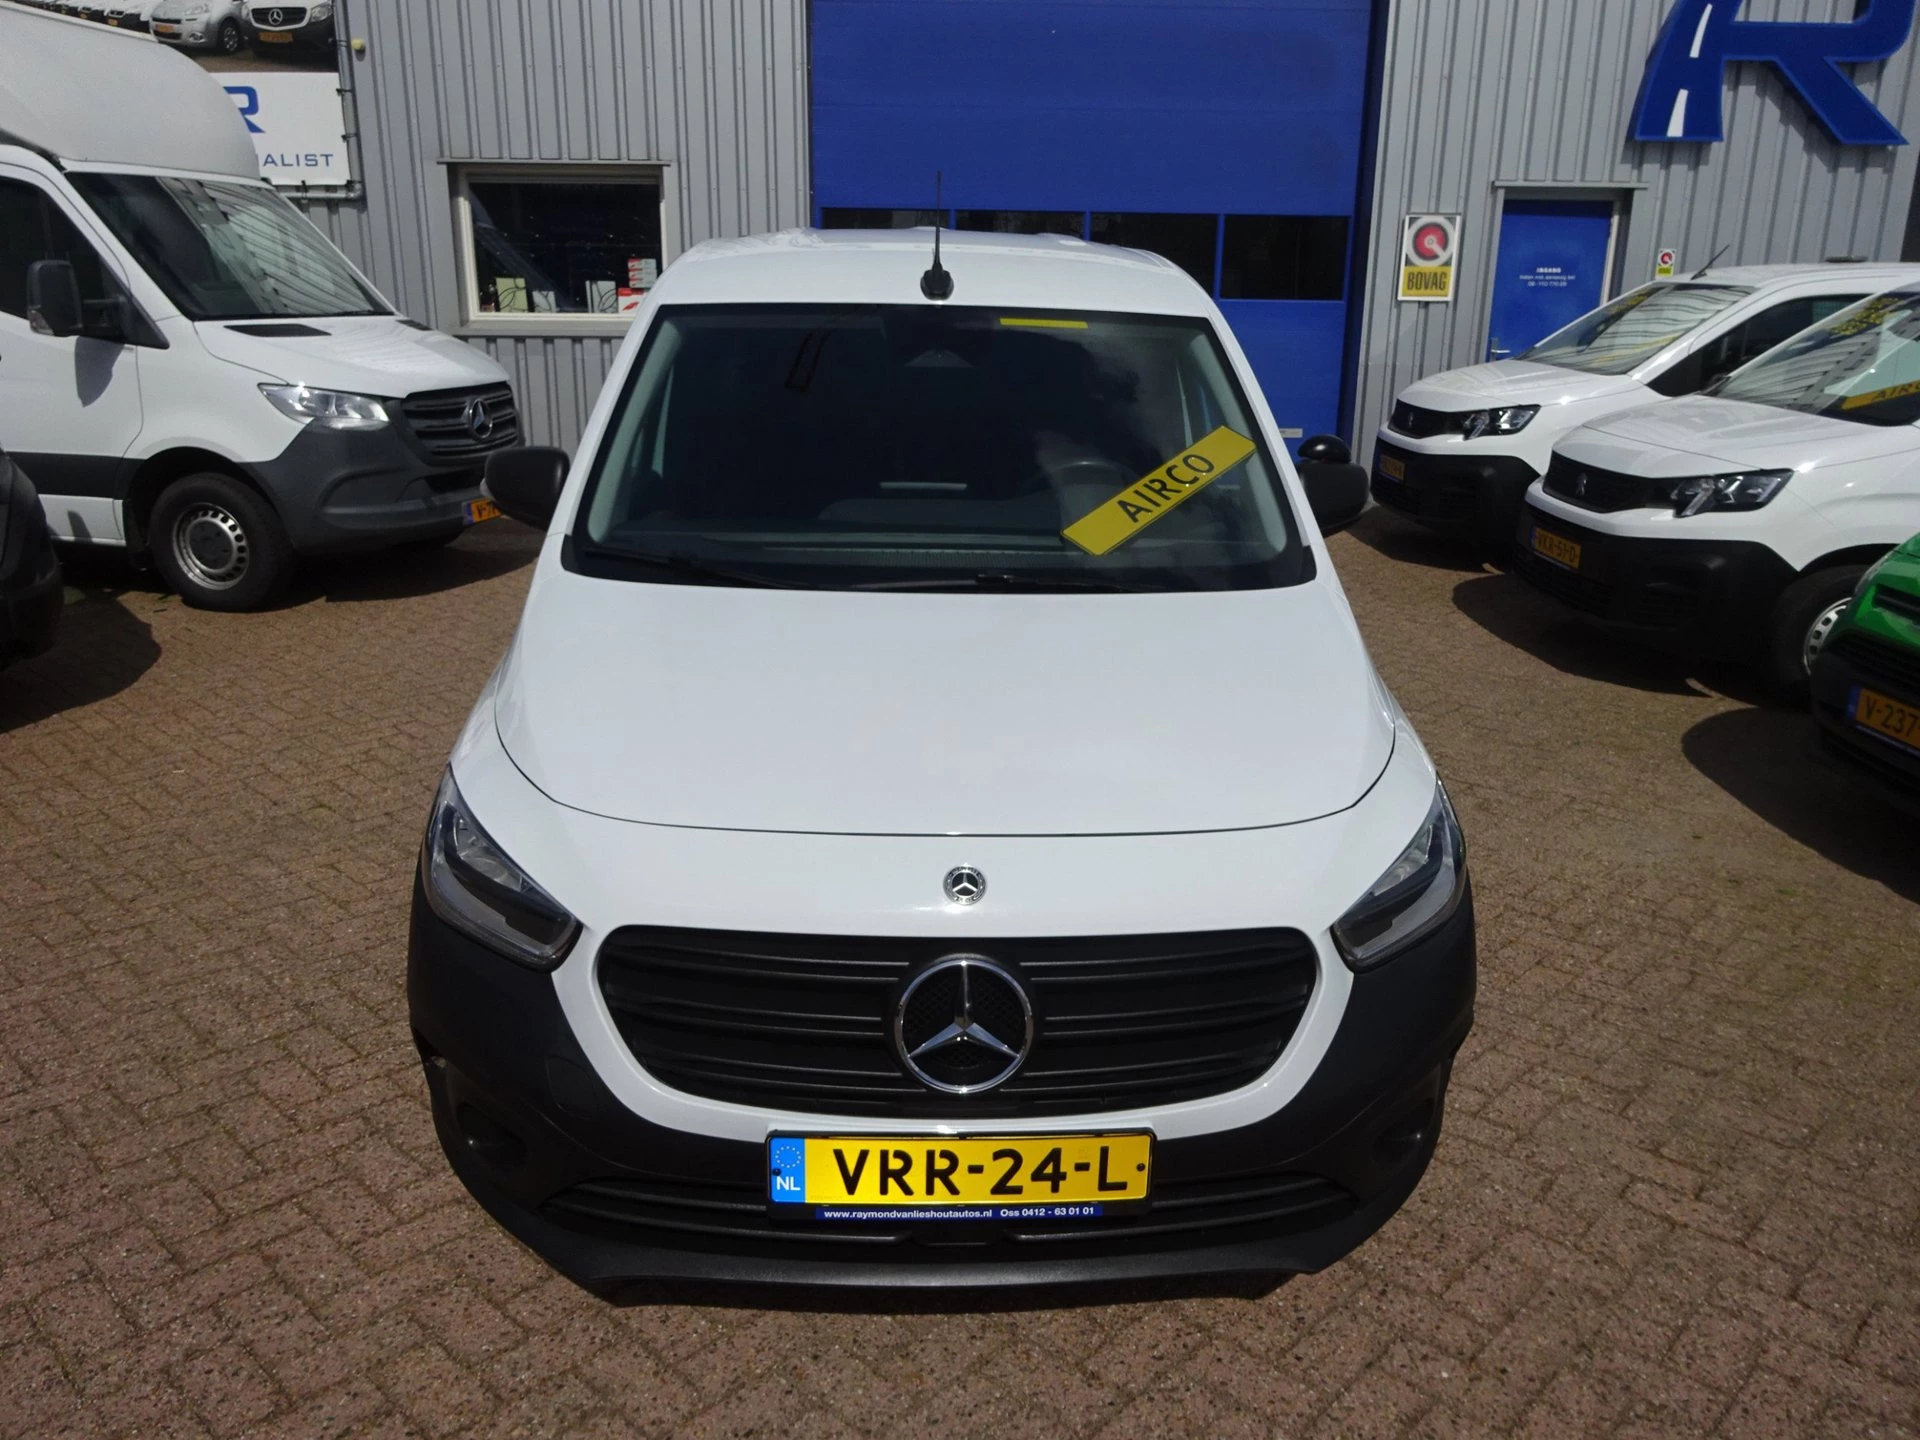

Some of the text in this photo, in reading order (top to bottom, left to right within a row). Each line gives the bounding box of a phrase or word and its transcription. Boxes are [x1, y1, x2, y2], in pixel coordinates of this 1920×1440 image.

[1407, 271, 1447, 290] BOVAG
[1116, 453, 1215, 523] AIRCO
[1864, 695, 1920, 738] V-237
[776, 1176, 801, 1191] NL
[832, 1146, 1128, 1196] VRR-24-L
[824, 1208, 993, 1220] www.raymondvanlieshoutautos.nl
[1000, 1208, 1020, 1217] Oss
[1022, 1208, 1046, 1217] 0412
[1068, 1207, 1080, 1216] 01
[1083, 1207, 1094, 1215] 01
